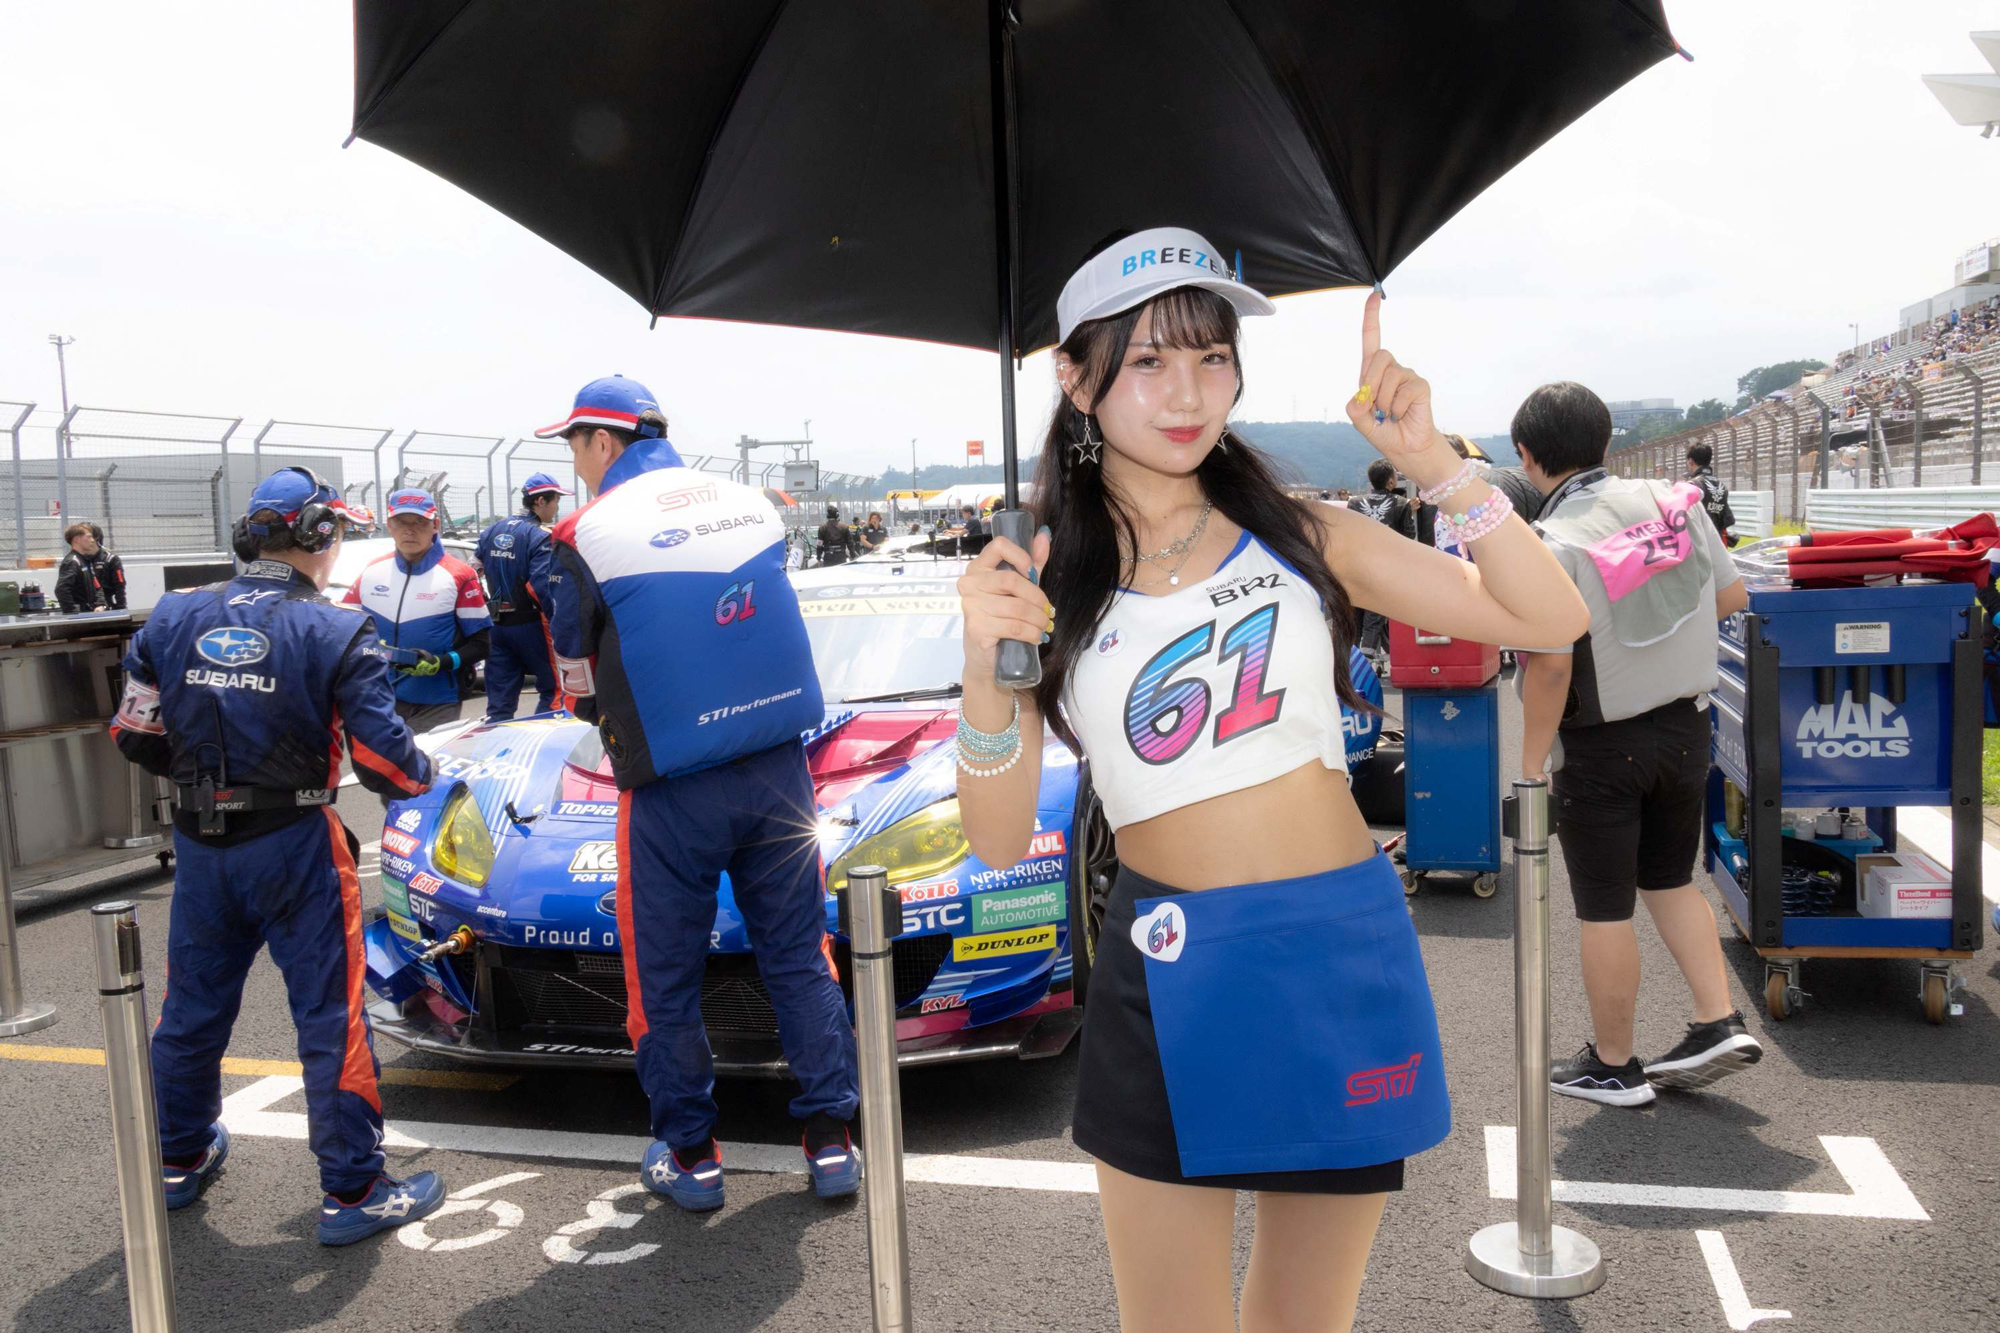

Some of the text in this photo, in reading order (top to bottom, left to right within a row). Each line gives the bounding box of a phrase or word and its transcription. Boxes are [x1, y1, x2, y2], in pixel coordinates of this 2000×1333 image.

[1122, 247, 1219, 277] BREEZE
[695, 514, 765, 536] SUBARU
[1624, 521, 1669, 540] MED
[1641, 535, 1679, 566] 25
[852, 584, 947, 596] SUBARU
[1205, 576, 1247, 593] SUBARU
[1209, 573, 1288, 607] BRZ
[714, 578, 757, 627] 61
[800, 602, 856, 614] even
[1098, 629, 1119, 654] 61
[186, 669, 276, 693] SUBARU
[1123, 601, 1287, 766] 61
[120, 696, 161, 723] 1-1
[697, 687, 802, 726] STI Performance
[1797, 690, 1909, 739] MAC
[1796, 740, 1910, 759] TOOLS
[214, 801, 246, 811] SPORT
[384, 830, 417, 854] MOTUL
[1029, 834, 1062, 855] TUL
[572, 843, 618, 870] Ke
[572, 874, 619, 882] FOR SM
[970, 859, 1063, 886] NPR-RIKEN
[978, 873, 1060, 890] Corporation
[409, 893, 435, 921] STC
[476, 905, 507, 917] accenture
[982, 890, 1057, 913] Panasonic
[981, 904, 1060, 927] AUTOMOTIVE
[525, 925, 590, 946] Proud
[602, 931, 621, 946] o
[975, 933, 1050, 952] DUNLOP
[1147, 911, 1178, 954] 61
[522, 1043, 636, 1056] STI Perfo
